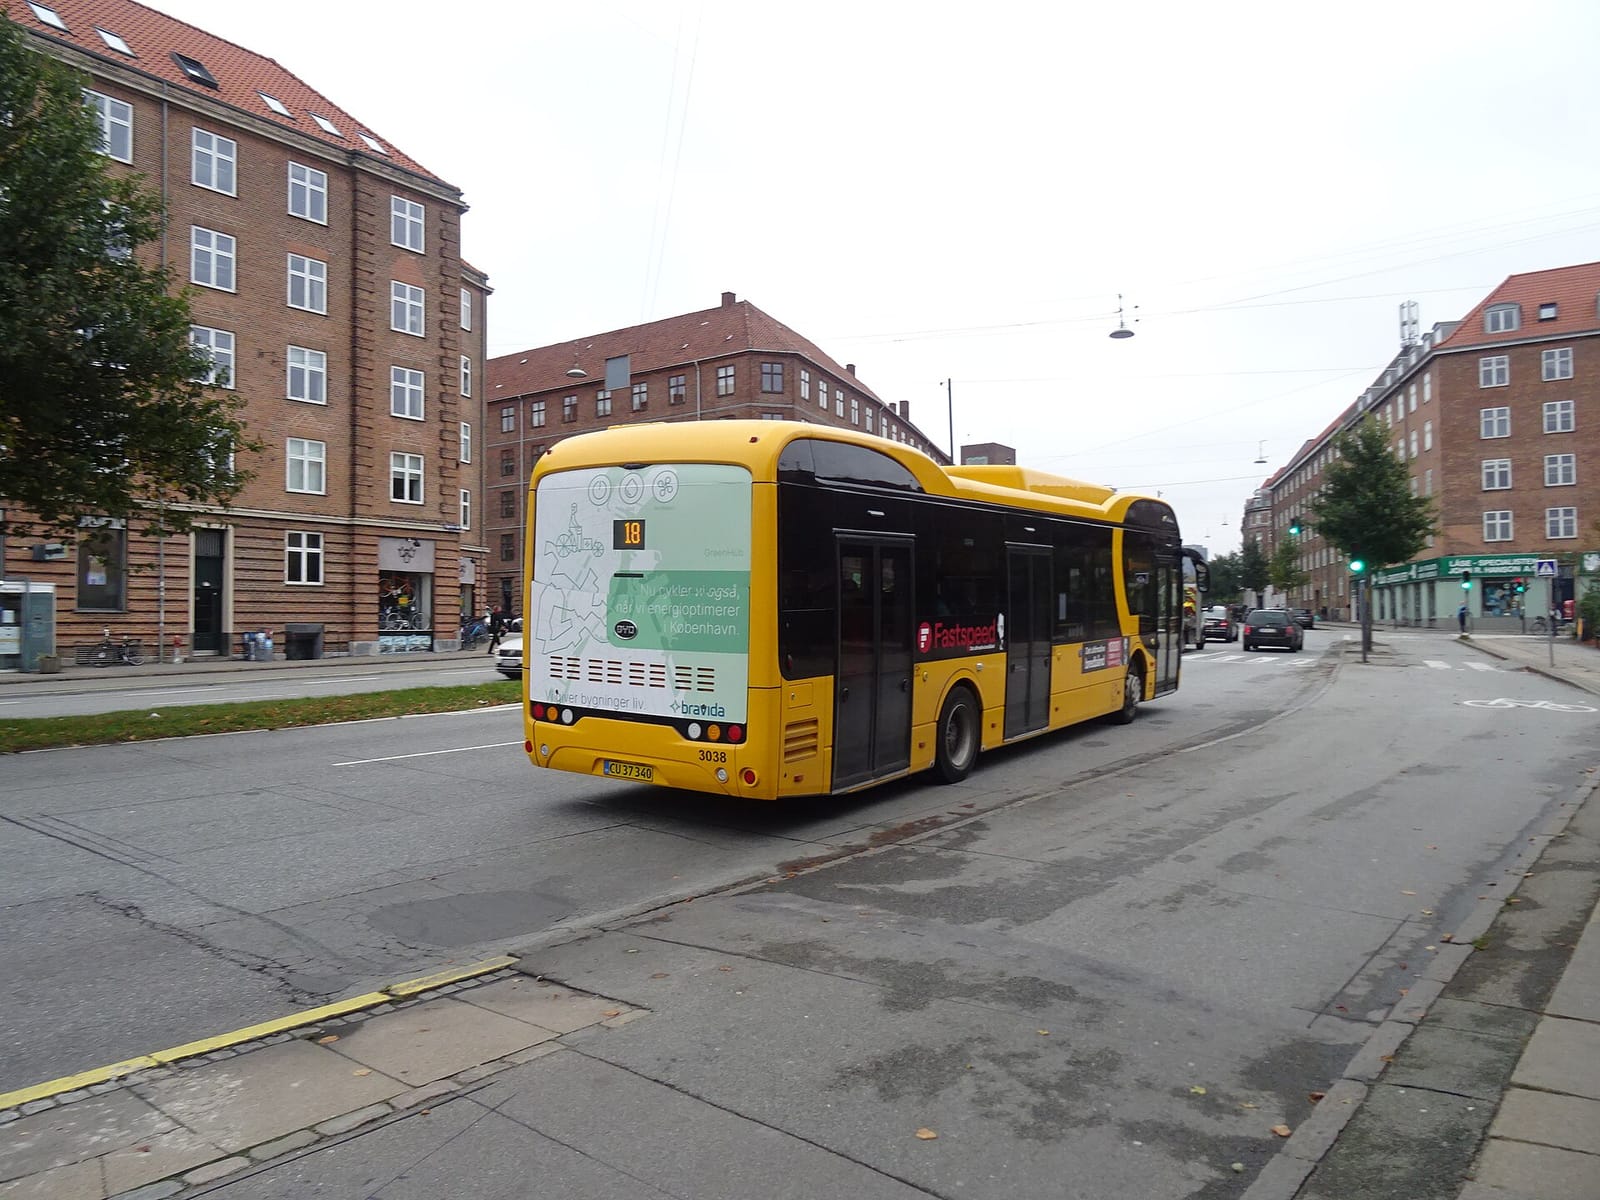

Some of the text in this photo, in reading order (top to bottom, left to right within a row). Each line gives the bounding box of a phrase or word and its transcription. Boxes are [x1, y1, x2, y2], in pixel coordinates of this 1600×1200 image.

[624, 522, 641, 544] 18
[660, 585, 692, 598] cykler
[616, 599, 632, 613] når
[648, 603, 740, 618] energioptimerer
[616, 625, 635, 634] BYD
[935, 618, 996, 652] Fastspeed
[581, 693, 629, 709] bygninger
[681, 701, 725, 717] bravida
[699, 749, 727, 763] 3038
[609, 763, 652, 779] CU 37 340
